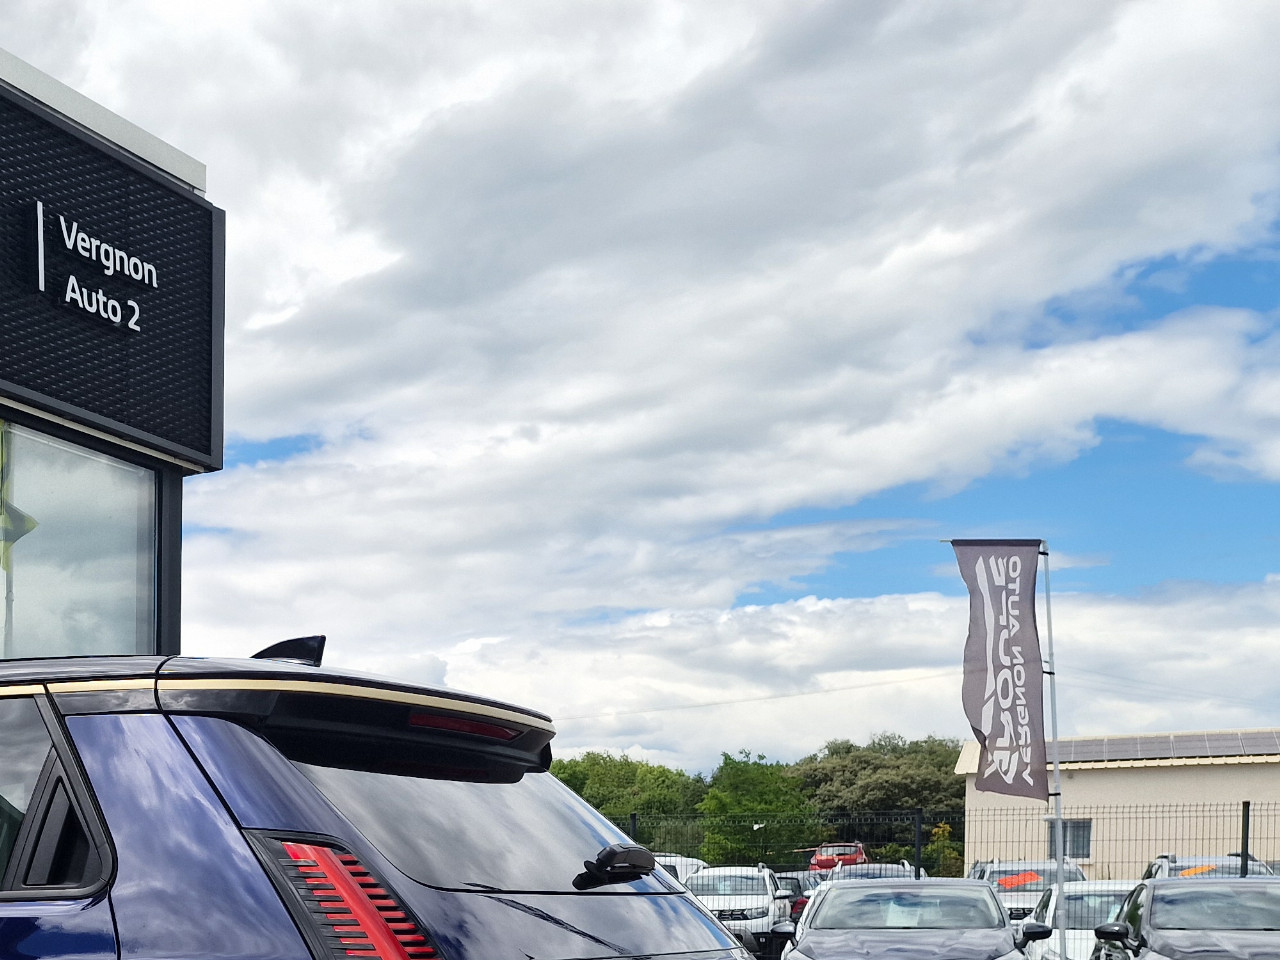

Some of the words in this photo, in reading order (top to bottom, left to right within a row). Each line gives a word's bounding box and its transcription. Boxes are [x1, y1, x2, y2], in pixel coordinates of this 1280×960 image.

[59, 214, 158, 289] Vergnon
[65, 274, 122, 323] Auto
[127, 300, 141, 332] 2
